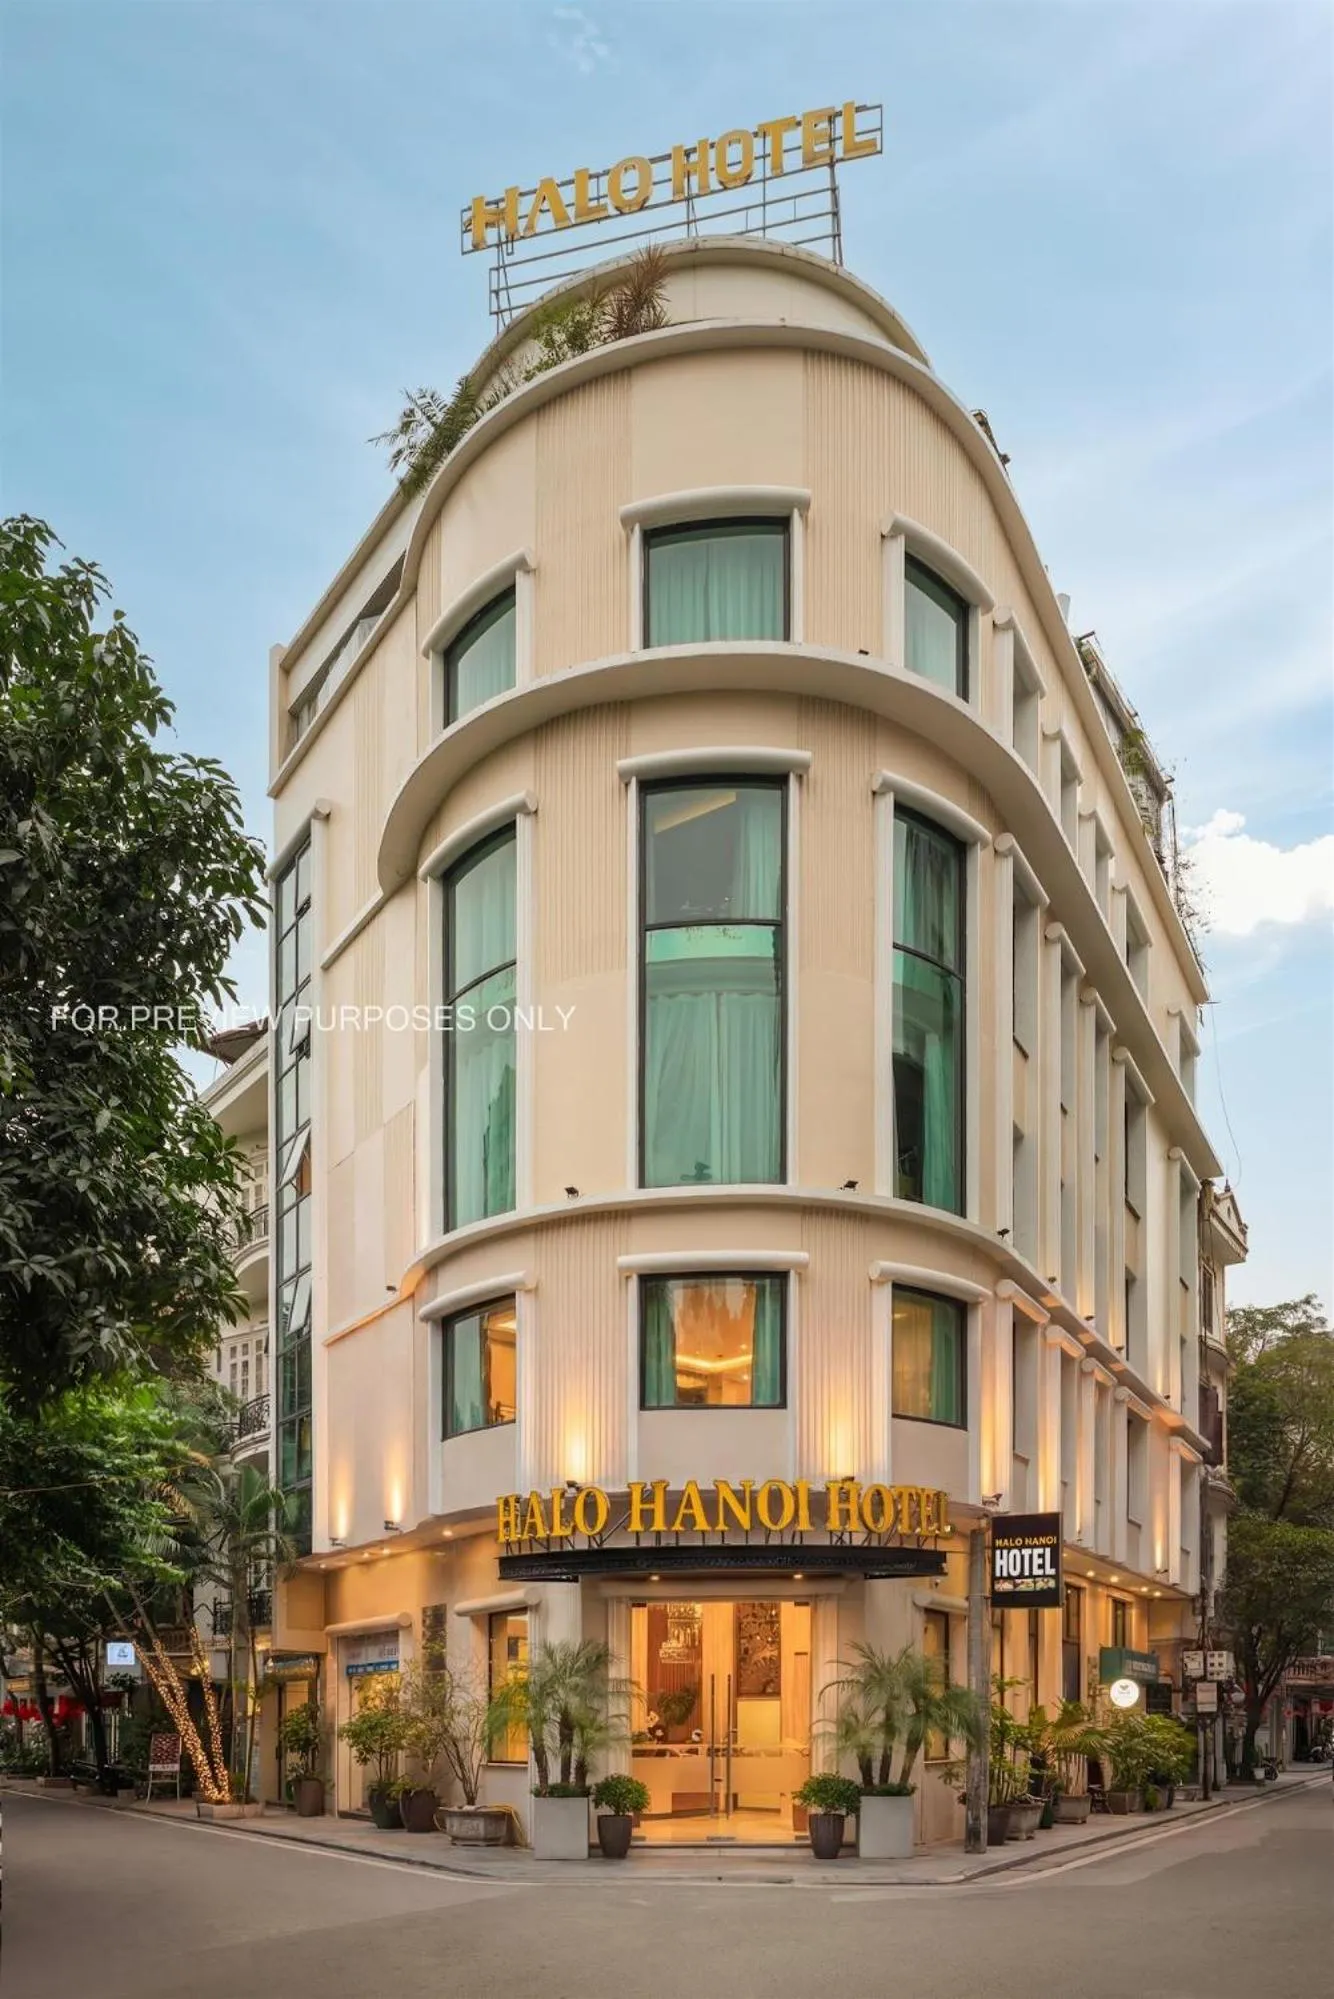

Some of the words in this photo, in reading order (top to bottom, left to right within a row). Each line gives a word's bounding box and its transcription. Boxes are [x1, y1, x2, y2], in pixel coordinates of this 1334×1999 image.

[467, 155, 654, 250] HALO
[671, 101, 878, 202] HOTEL
[496, 1486, 610, 1544] HALO
[627, 1479, 814, 1534] HANOI
[826, 1480, 955, 1540] HOTEL
[995, 1537, 1022, 1547] HALO
[1025, 1536, 1056, 1546] HANOI
[995, 1547, 1056, 1577] HOTEL
